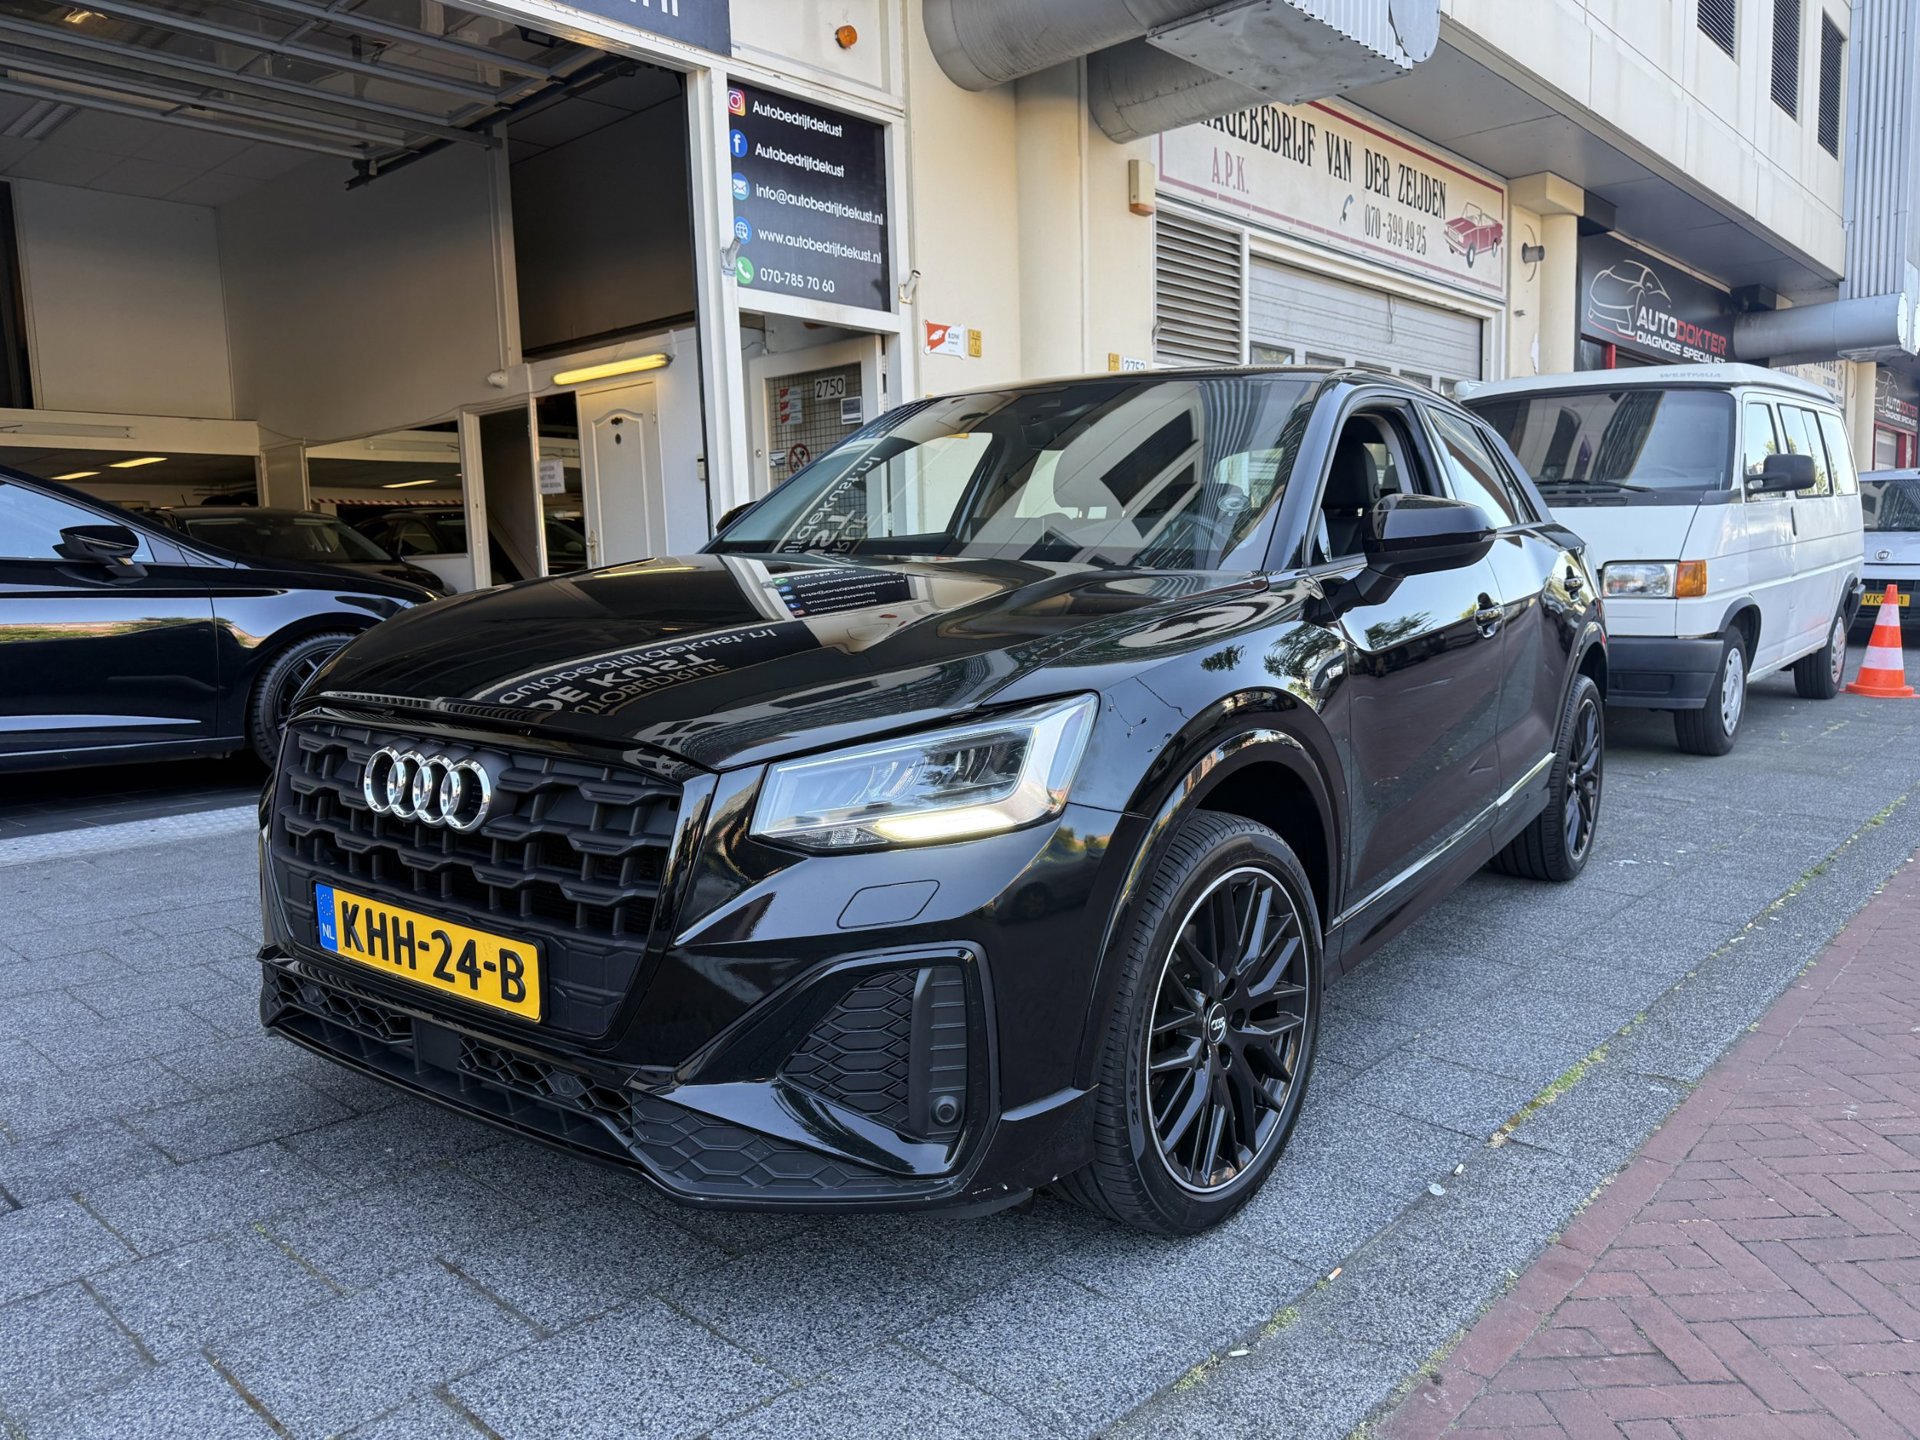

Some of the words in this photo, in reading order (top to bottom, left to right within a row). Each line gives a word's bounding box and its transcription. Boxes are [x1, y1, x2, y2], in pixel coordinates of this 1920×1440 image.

[752, 100, 843, 138] Autobedrijfdekust
[754, 142, 845, 178] Autobedrijfdekust
[1211, 146, 1250, 194] A.P.K.
[1325, 130, 1352, 183] VAN
[1365, 148, 1390, 198] DER
[1398, 162, 1446, 220] ZEIJDEN
[756, 183, 884, 226] info@autobedrijfdekust.nl
[757, 228, 882, 264] www.autobedrijfdekust.nl
[760, 267, 804, 288] 070-785
[806, 276, 820, 291] 70
[821, 279, 835, 293] 60
[1636, 305, 1727, 356] AUTODOKTER
[1636, 330, 1682, 356] DIAGNOSE
[815, 377, 844, 398] 2750
[322, 922, 335, 941] NL
[341, 900, 526, 1004] KHH-24-B
